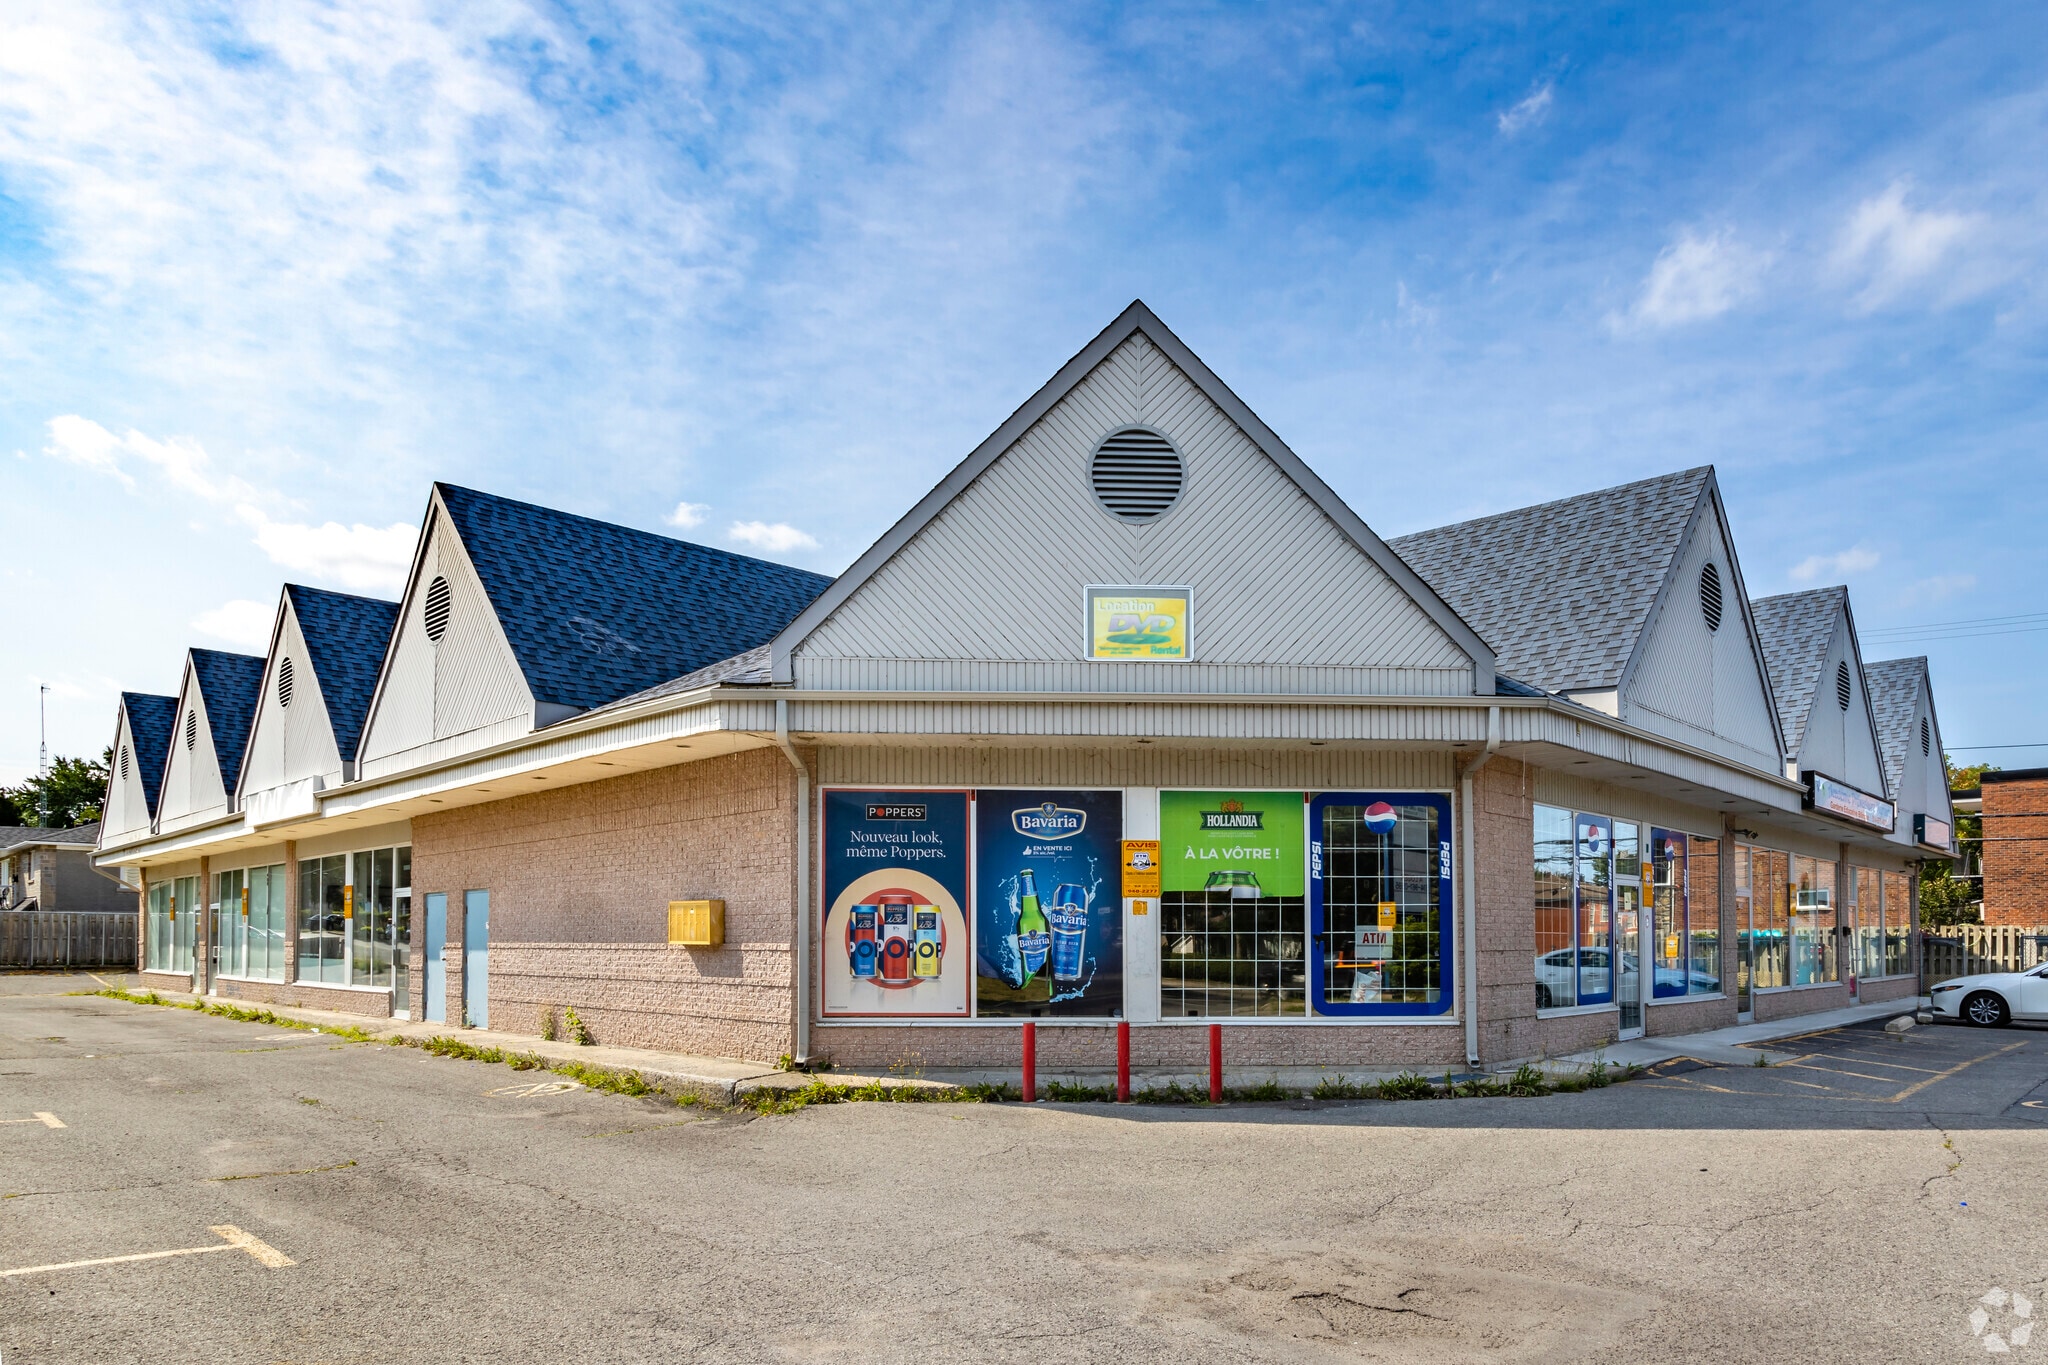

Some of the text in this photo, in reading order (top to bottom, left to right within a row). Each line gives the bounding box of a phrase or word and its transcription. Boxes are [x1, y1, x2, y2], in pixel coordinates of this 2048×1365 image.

[1097, 599, 1155, 612] Location
[1108, 613, 1176, 634] DVD
[1150, 646, 1181, 655] Rental
[1021, 815, 1077, 829] Bavaria
[1207, 814, 1258, 827] HOLLANDIA
[850, 831, 943, 845] Nouveau look,
[846, 845, 946, 860] même Poppers.
[1184, 845, 1196, 860] À
[1199, 848, 1219, 860] LA
[1222, 845, 1272, 860] VÔTRE
[1311, 841, 1322, 879] PEPSI
[1440, 841, 1451, 879] PEPSI
[1051, 913, 1087, 926] Bavaria
[1019, 937, 1050, 948] Bavaria
